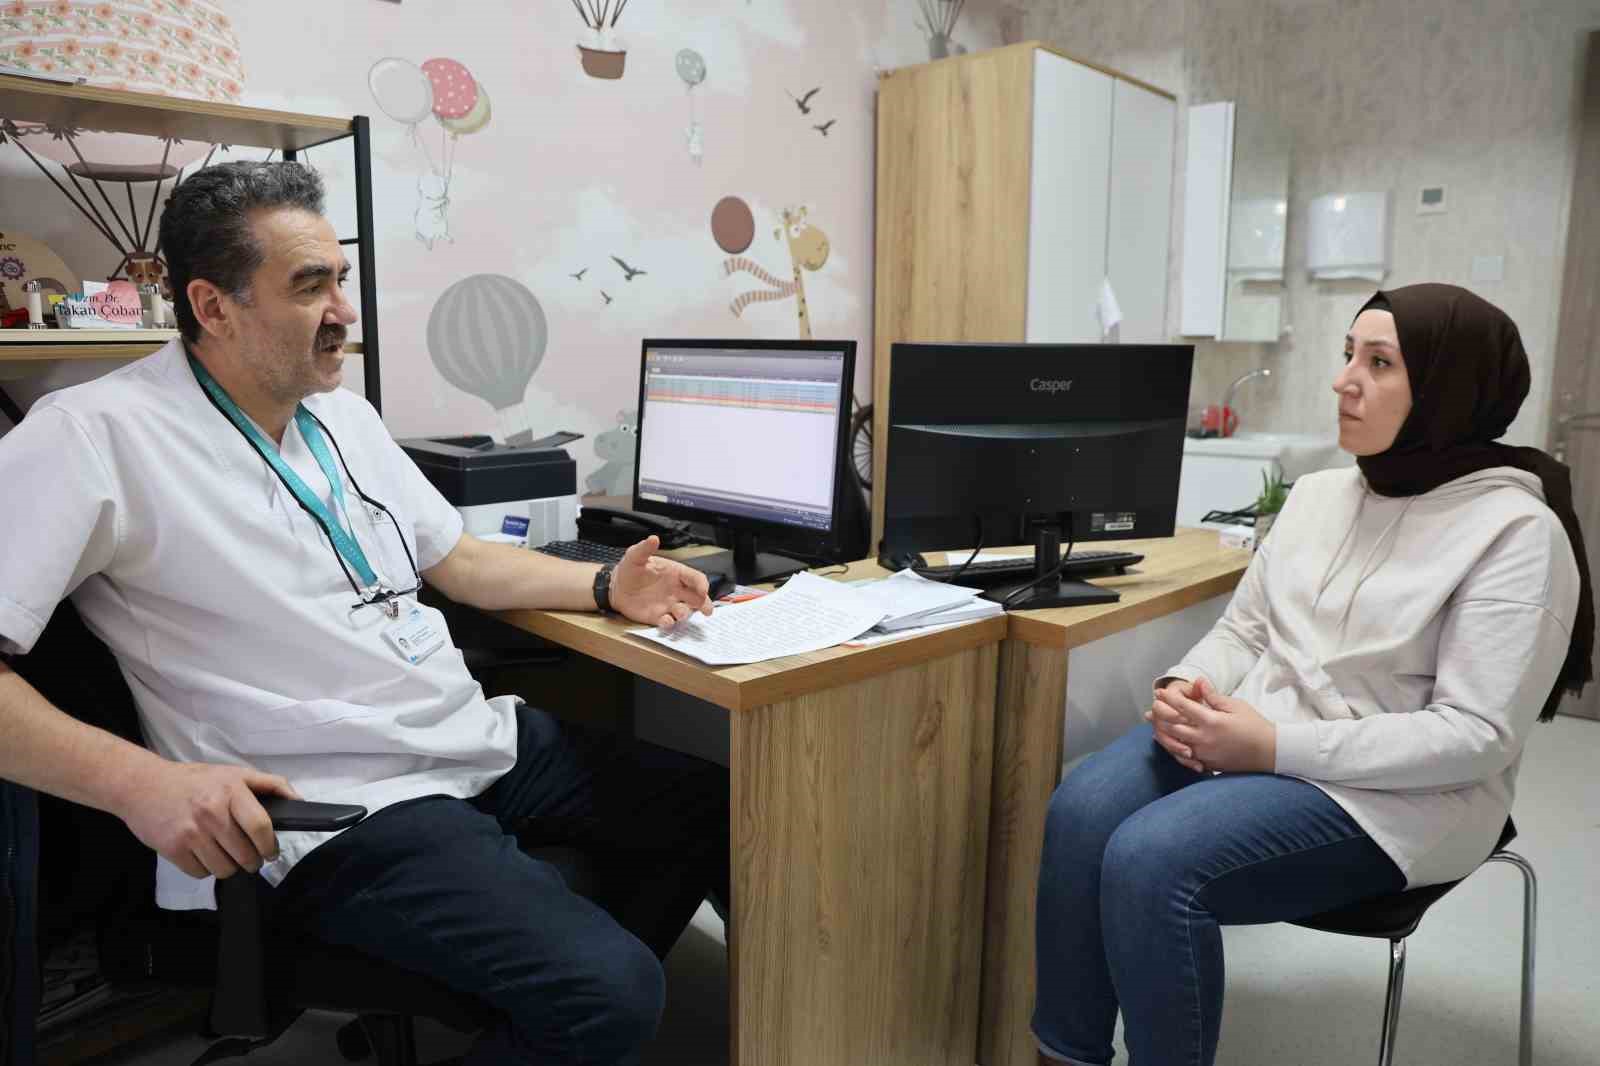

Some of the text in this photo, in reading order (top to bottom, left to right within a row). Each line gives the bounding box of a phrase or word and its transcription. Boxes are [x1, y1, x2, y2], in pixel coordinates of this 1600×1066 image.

[104, 294, 120, 303] Dr.
[101, 304, 144, 319] Çoban
[1030, 378, 1072, 396] Casper
